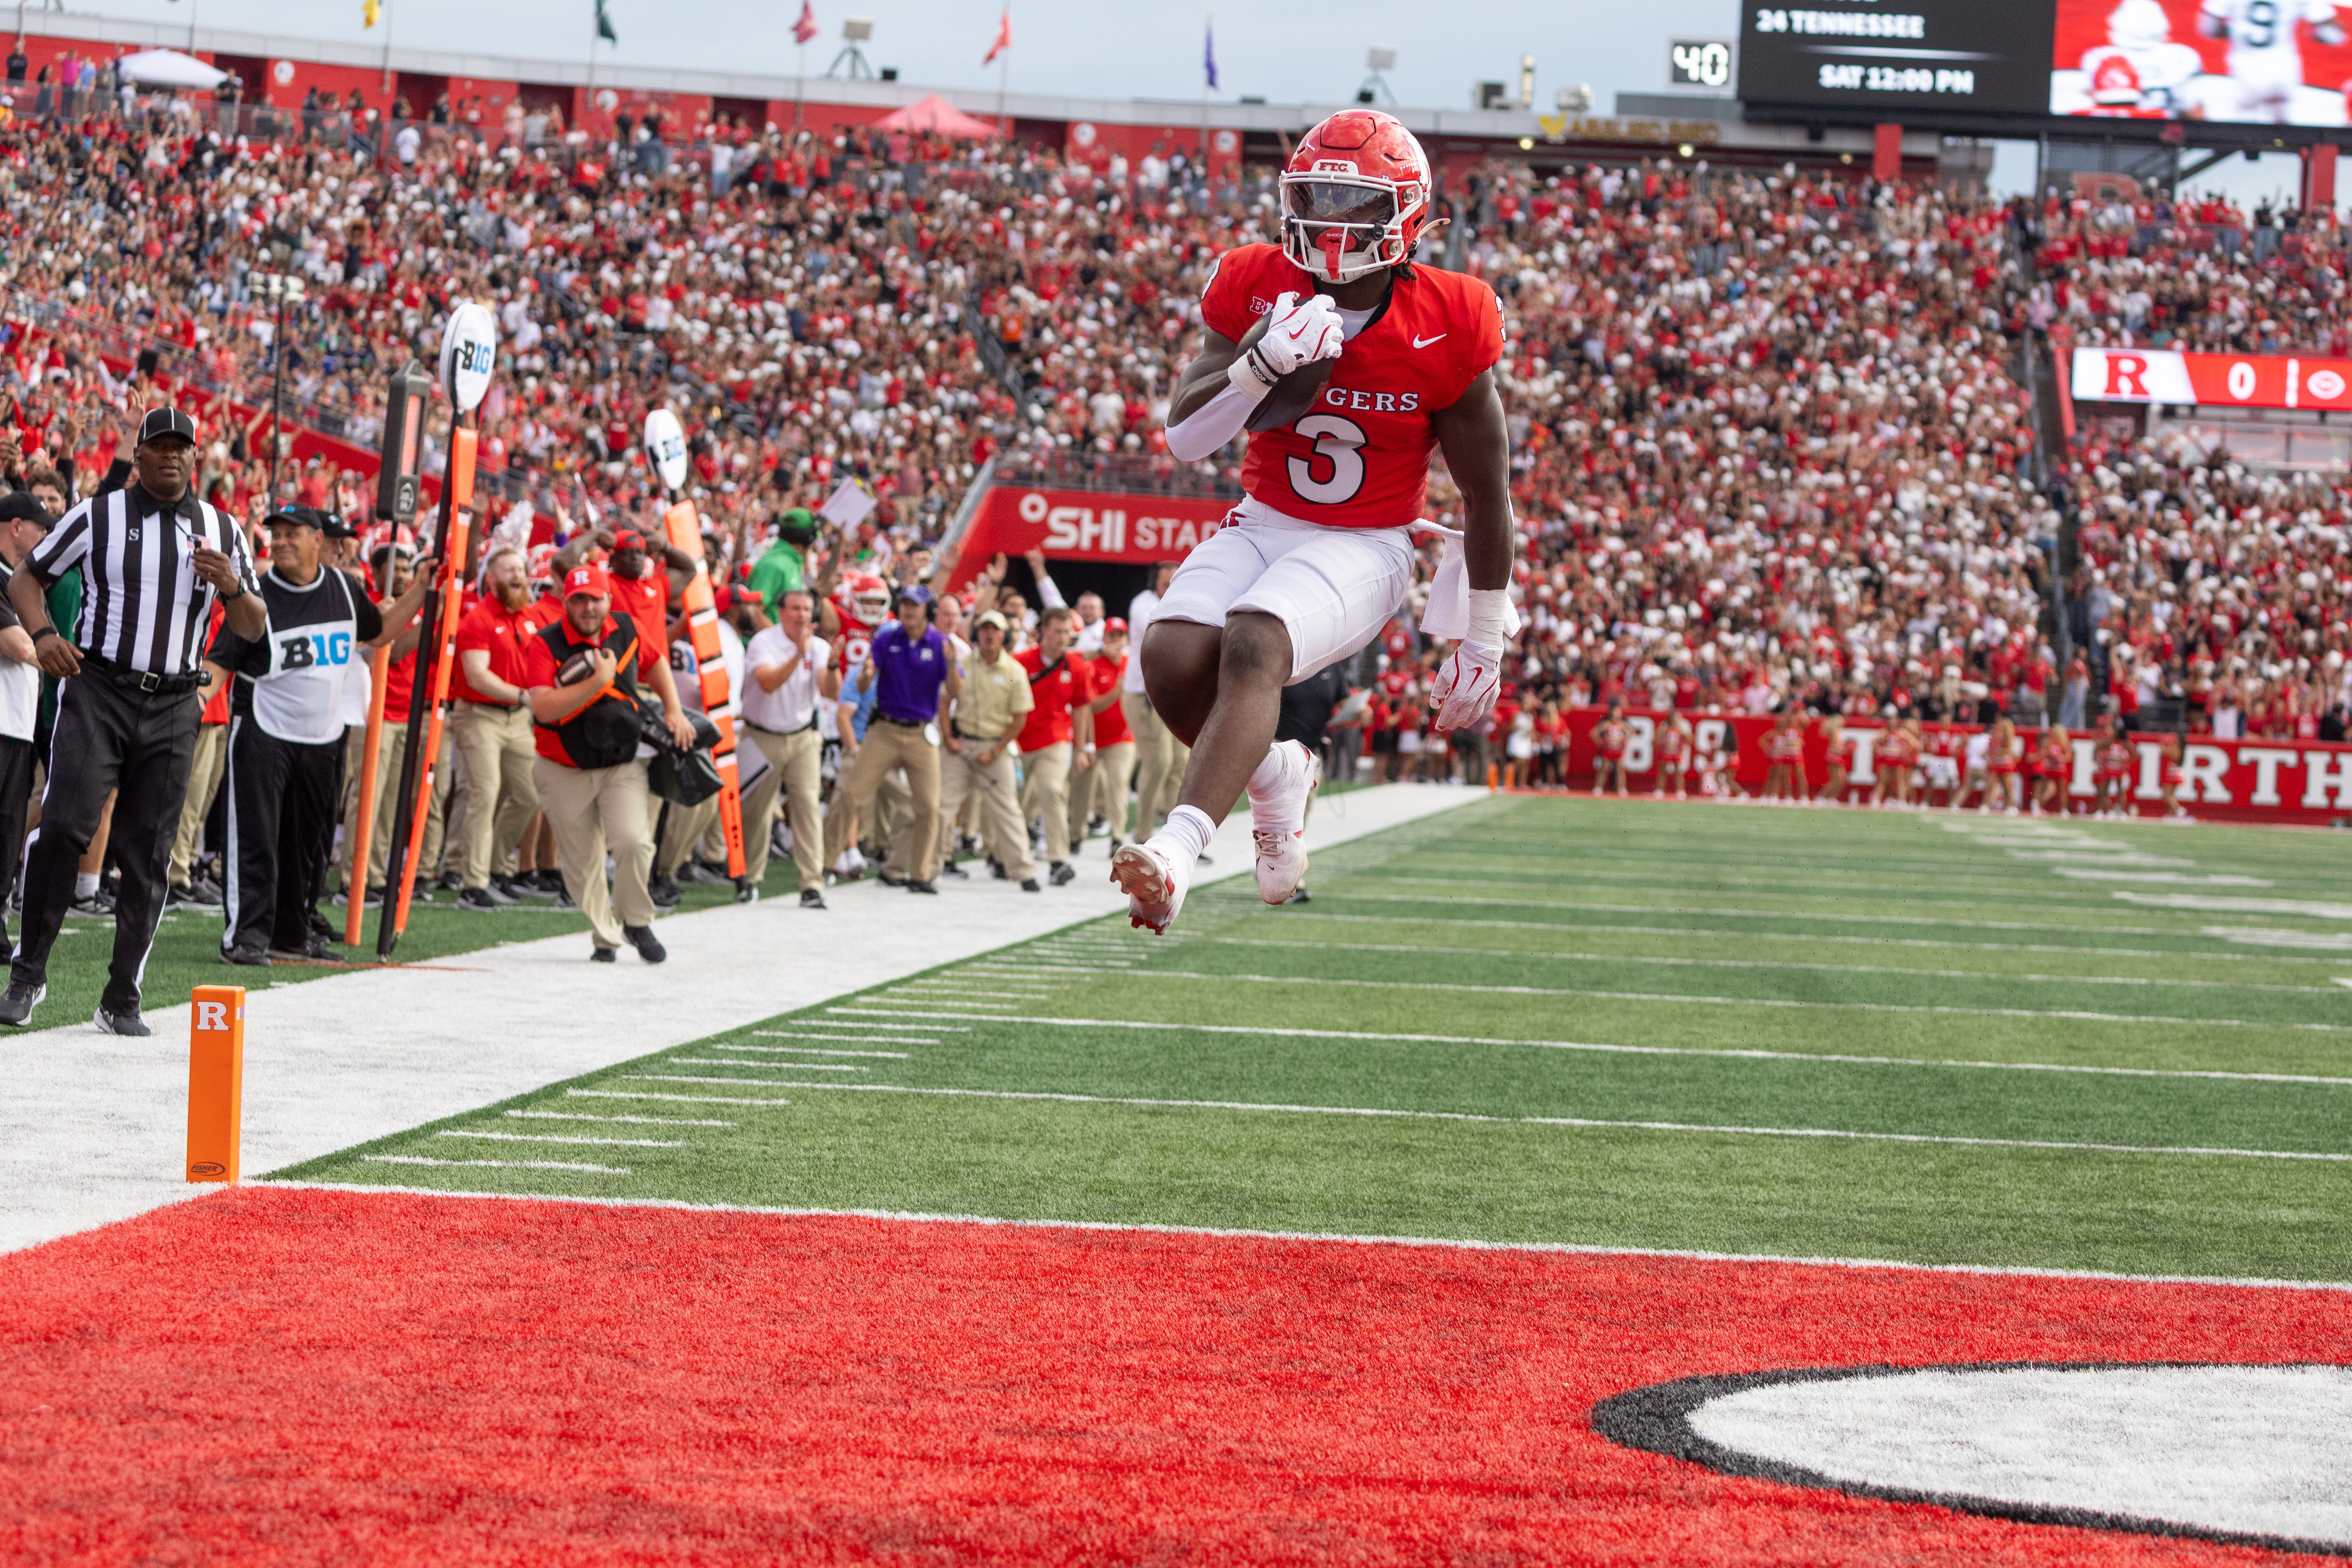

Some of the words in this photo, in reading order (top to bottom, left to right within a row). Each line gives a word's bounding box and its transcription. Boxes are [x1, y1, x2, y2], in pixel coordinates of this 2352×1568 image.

[1757, 9, 1788, 32] 24
[1789, 10, 1925, 38] TENNESSEE
[1673, 43, 1728, 86] 40
[1819, 64, 1864, 88] SAT
[1866, 67, 1934, 93] 12:00
[1936, 70, 1974, 94] PM
[1250, 296, 1273, 316] B1
[1251, 365, 1267, 382] CHOP
[2105, 355, 2150, 395] R
[2228, 361, 2256, 400] 0
[1325, 387, 1420, 412] GERS
[1285, 412, 1369, 505] 3
[129, 528, 139, 541] S
[1042, 507, 1126, 552] SHI
[1134, 516, 1220, 550] STAD
[573, 570, 590, 586] R
[280, 631, 350, 671] B1G
[197, 1001, 229, 1031] R
